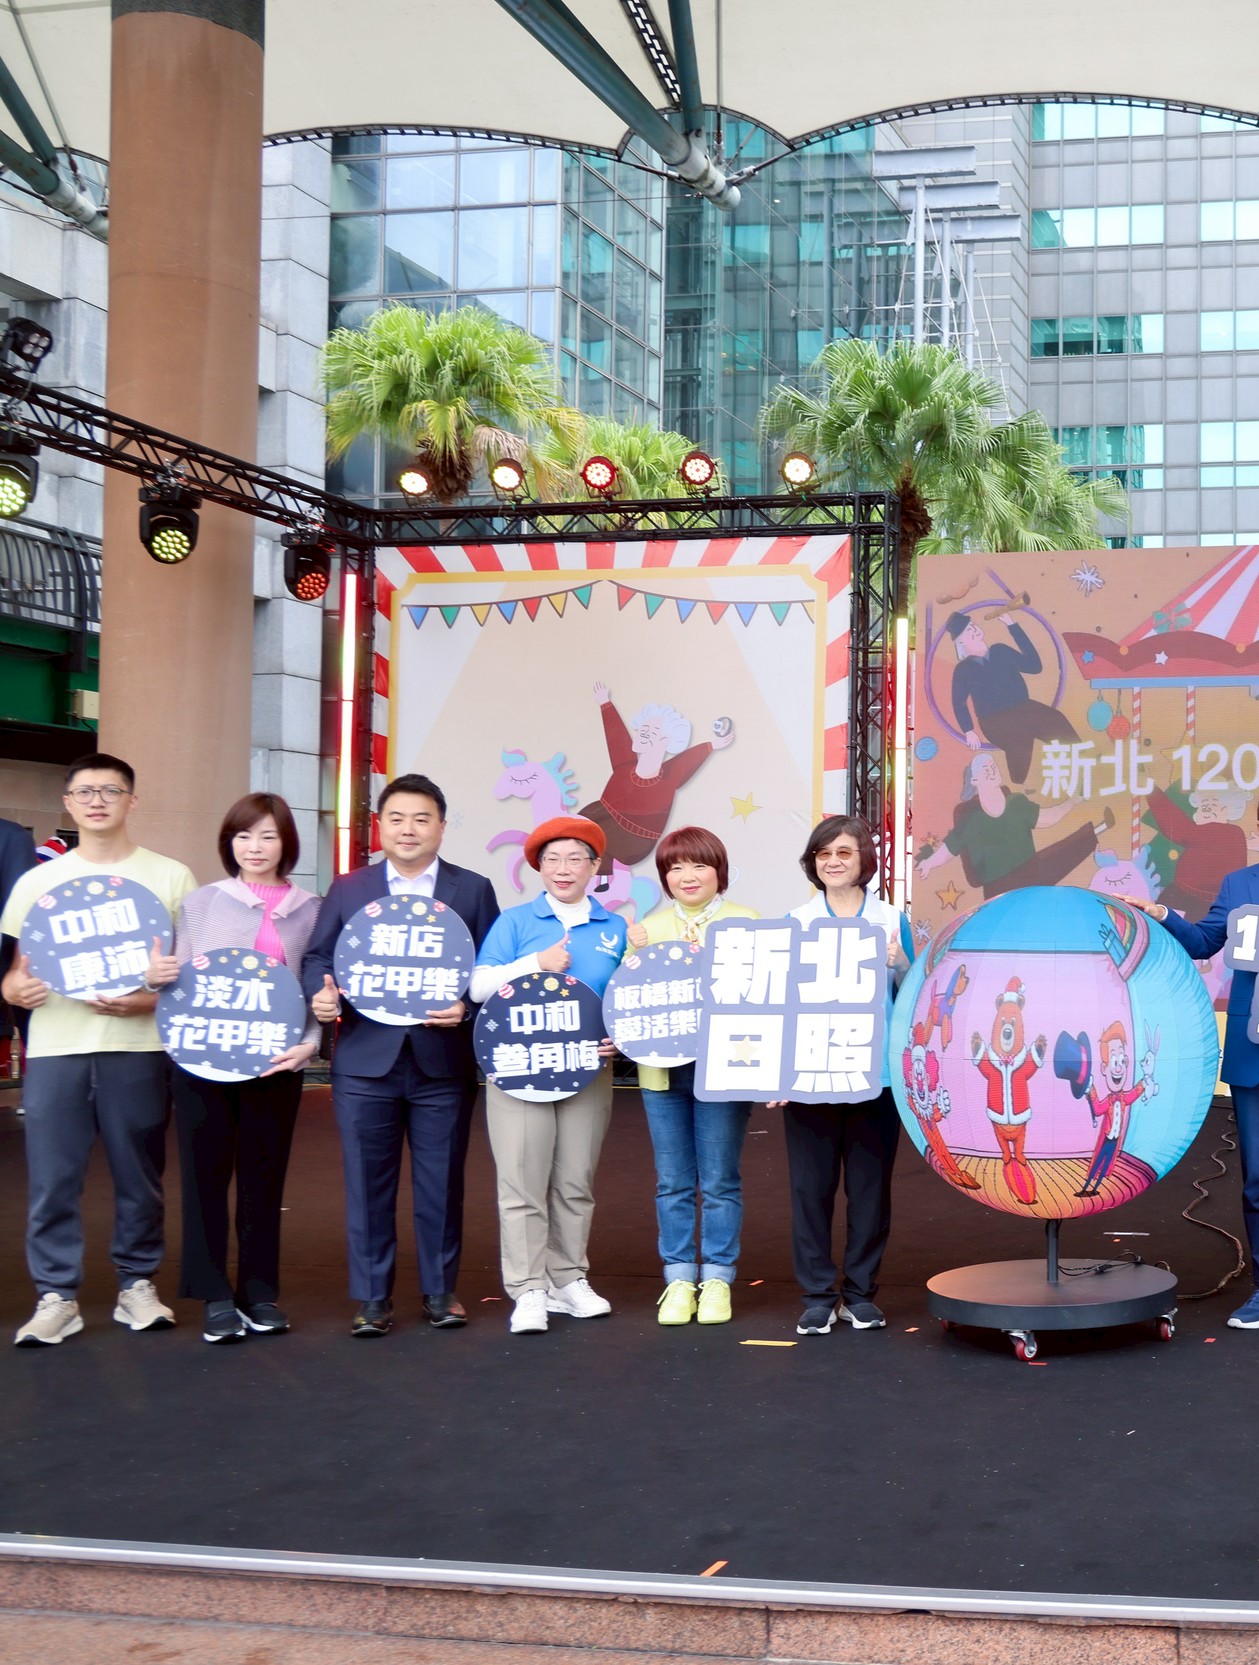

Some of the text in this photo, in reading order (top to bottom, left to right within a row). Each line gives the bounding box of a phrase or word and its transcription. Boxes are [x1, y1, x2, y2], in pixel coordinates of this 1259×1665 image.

[1041, 739, 1155, 799] 新北
[48, 897, 140, 944] 中和
[368, 923, 445, 958] 新店
[58, 940, 151, 991] 康沛
[347, 963, 460, 1001] 花甲樂
[709, 926, 877, 1005] 新北
[191, 974, 275, 1012] 淡水
[613, 976, 704, 1011] 板橋新
[167, 1014, 288, 1056] 花甲樂
[509, 1000, 581, 1035] 中和
[613, 1008, 703, 1043] 愛活樂
[704, 1013, 875, 1093] 日照
